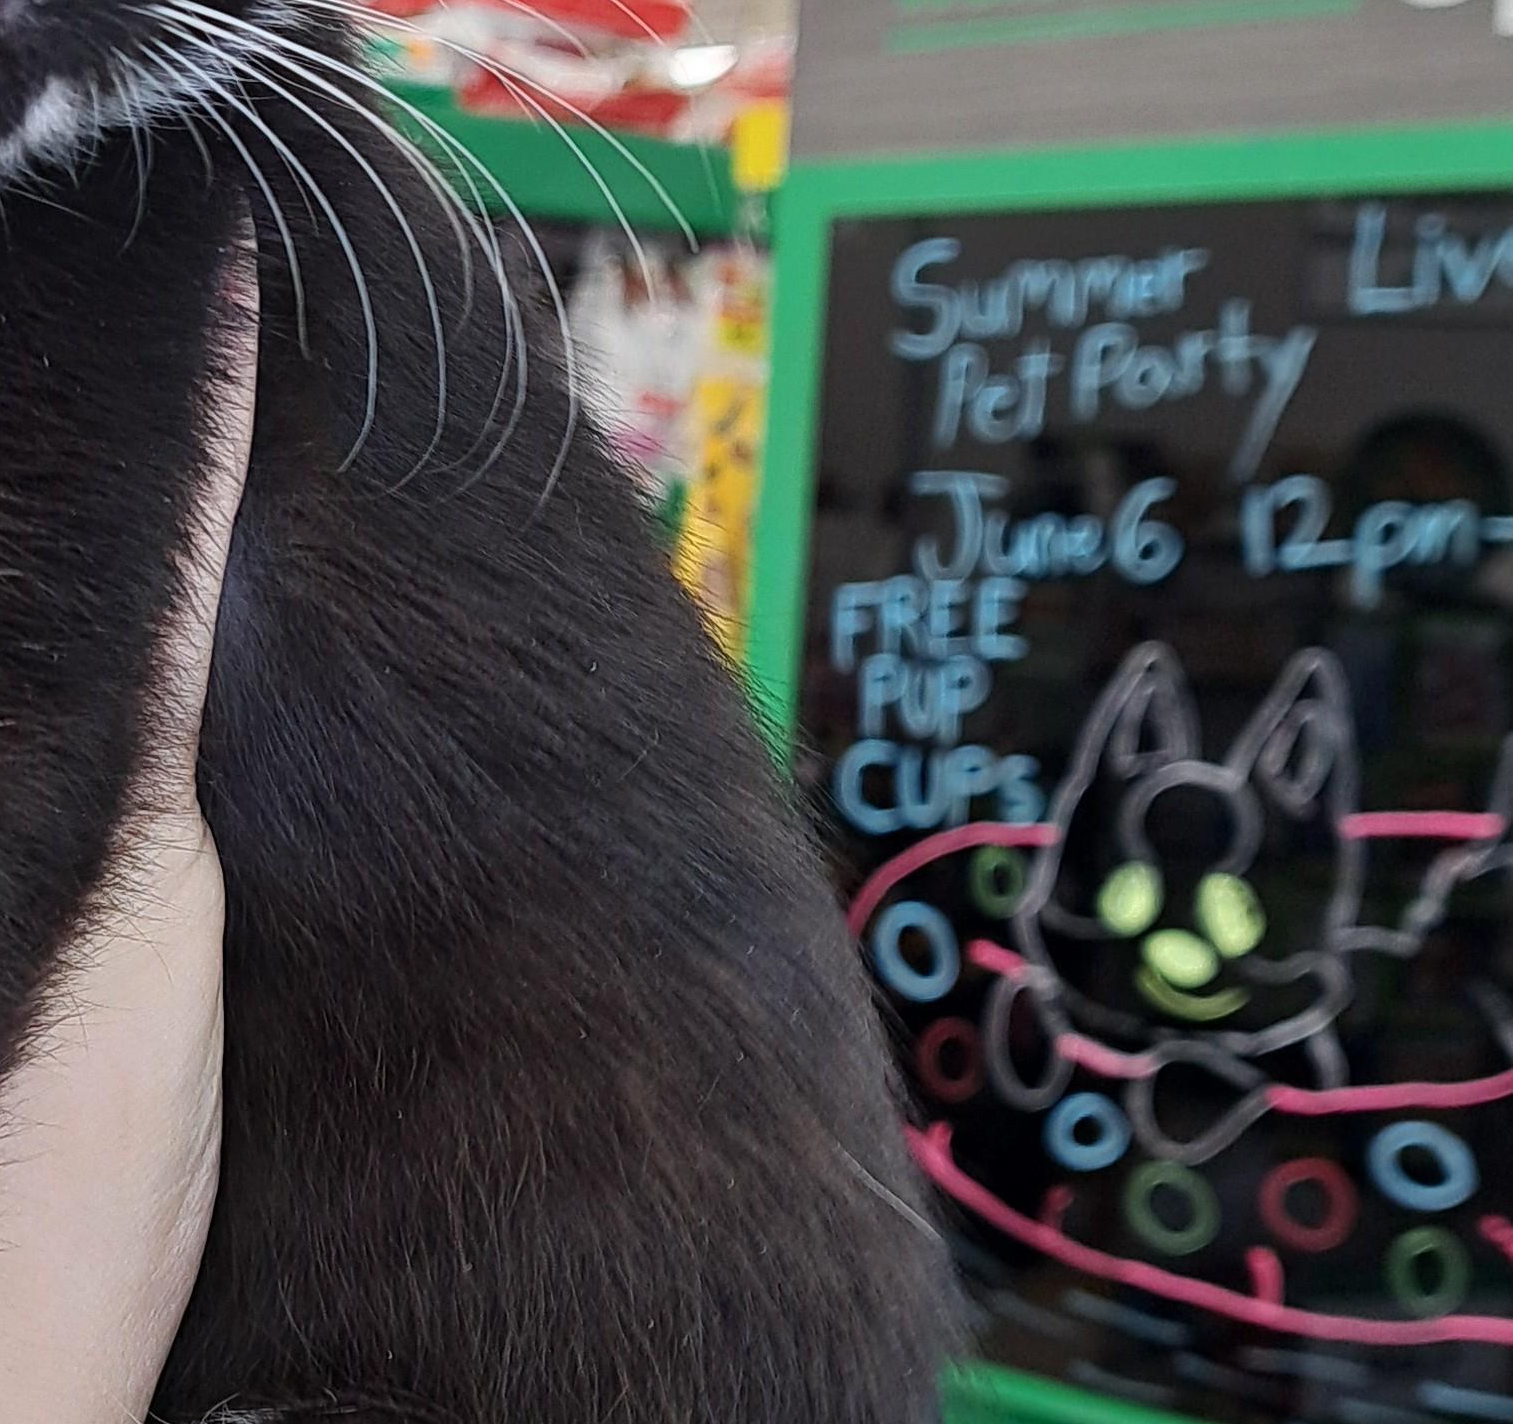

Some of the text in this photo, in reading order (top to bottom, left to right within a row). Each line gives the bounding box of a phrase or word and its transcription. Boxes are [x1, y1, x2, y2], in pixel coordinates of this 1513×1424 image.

[892, 237, 1211, 359] Summer
[933, 297, 1318, 479] Pet Party
[830, 574, 1031, 673] FREE
[857, 652, 993, 746] PUP
[832, 738, 1047, 836] CUPS
